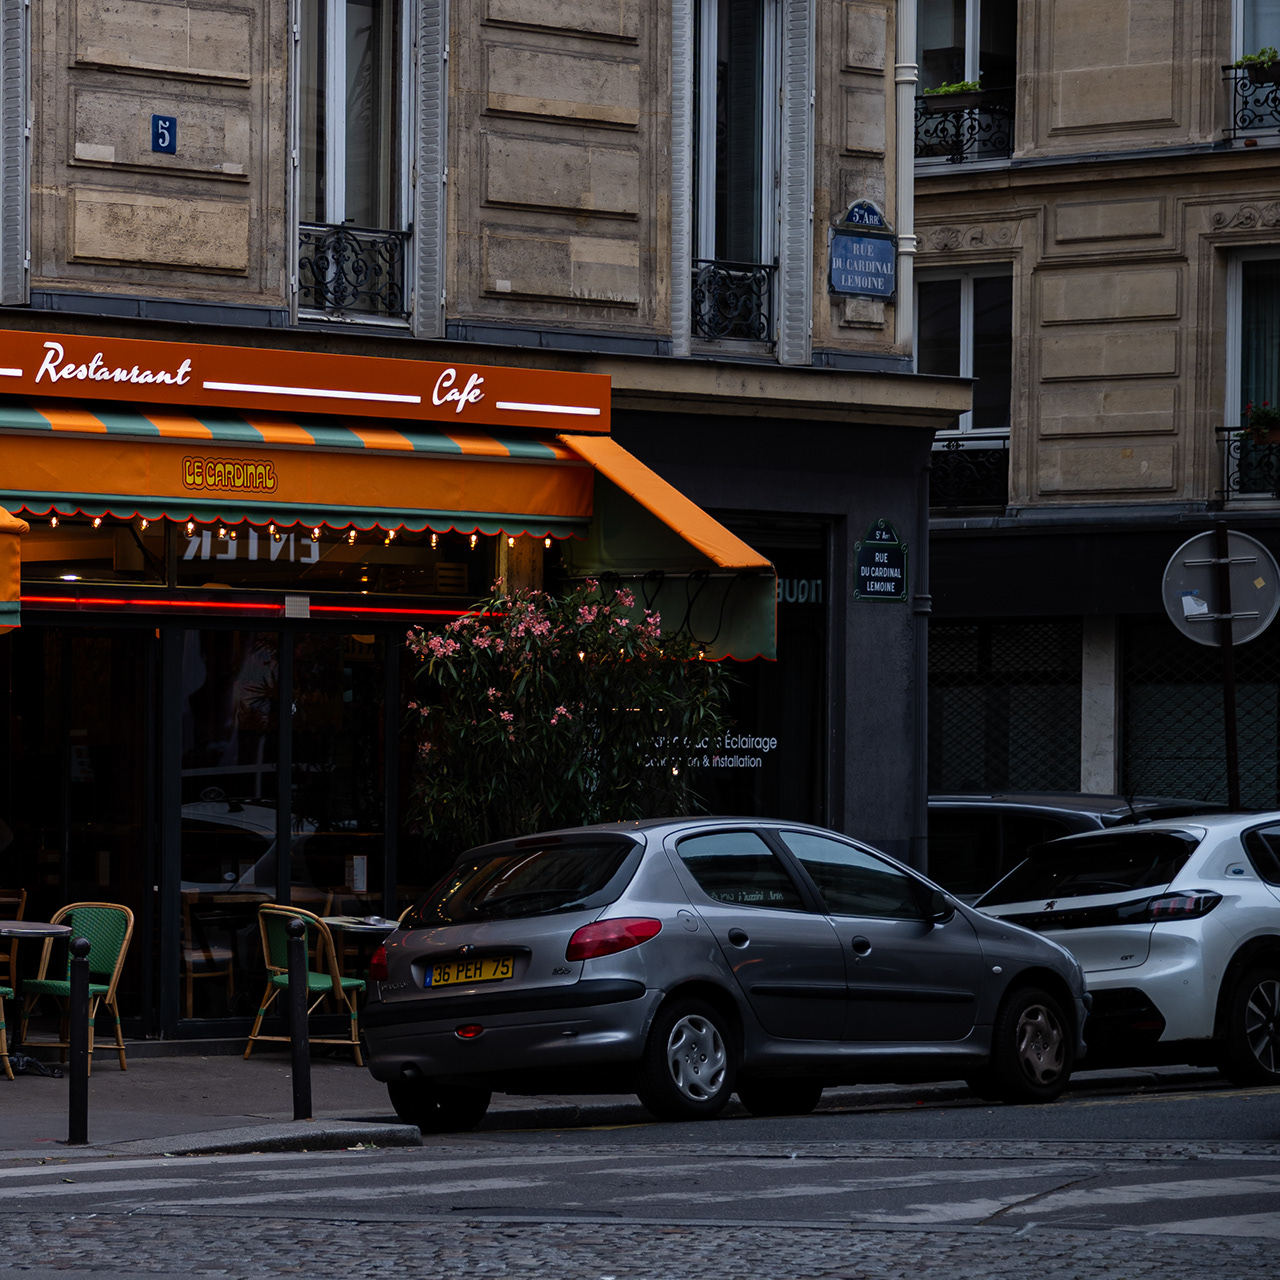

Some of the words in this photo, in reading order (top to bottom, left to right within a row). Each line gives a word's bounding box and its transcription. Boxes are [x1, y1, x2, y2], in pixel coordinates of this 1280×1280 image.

[158, 120, 171, 147] 5
[853, 242, 874, 257] RUE
[832, 257, 846, 270] DU
[846, 258, 894, 275] CARDINAL
[841, 274, 885, 290] LEMOINE
[34, 341, 192, 386] Restaurant
[432, 367, 486, 413] Café
[183, 460, 203, 484] LE
[204, 461, 276, 490] CARDINAL
[874, 552, 889, 563] RUE
[860, 566, 870, 577] DU
[870, 567, 902, 578] CARDINAL
[866, 580, 896, 592] LEMOINE
[724, 729, 778, 753] Éclairage
[702, 755, 711, 768] &
[434, 964, 451, 983] 36
[456, 960, 483, 981] PEH
[491, 958, 510, 976] 75
